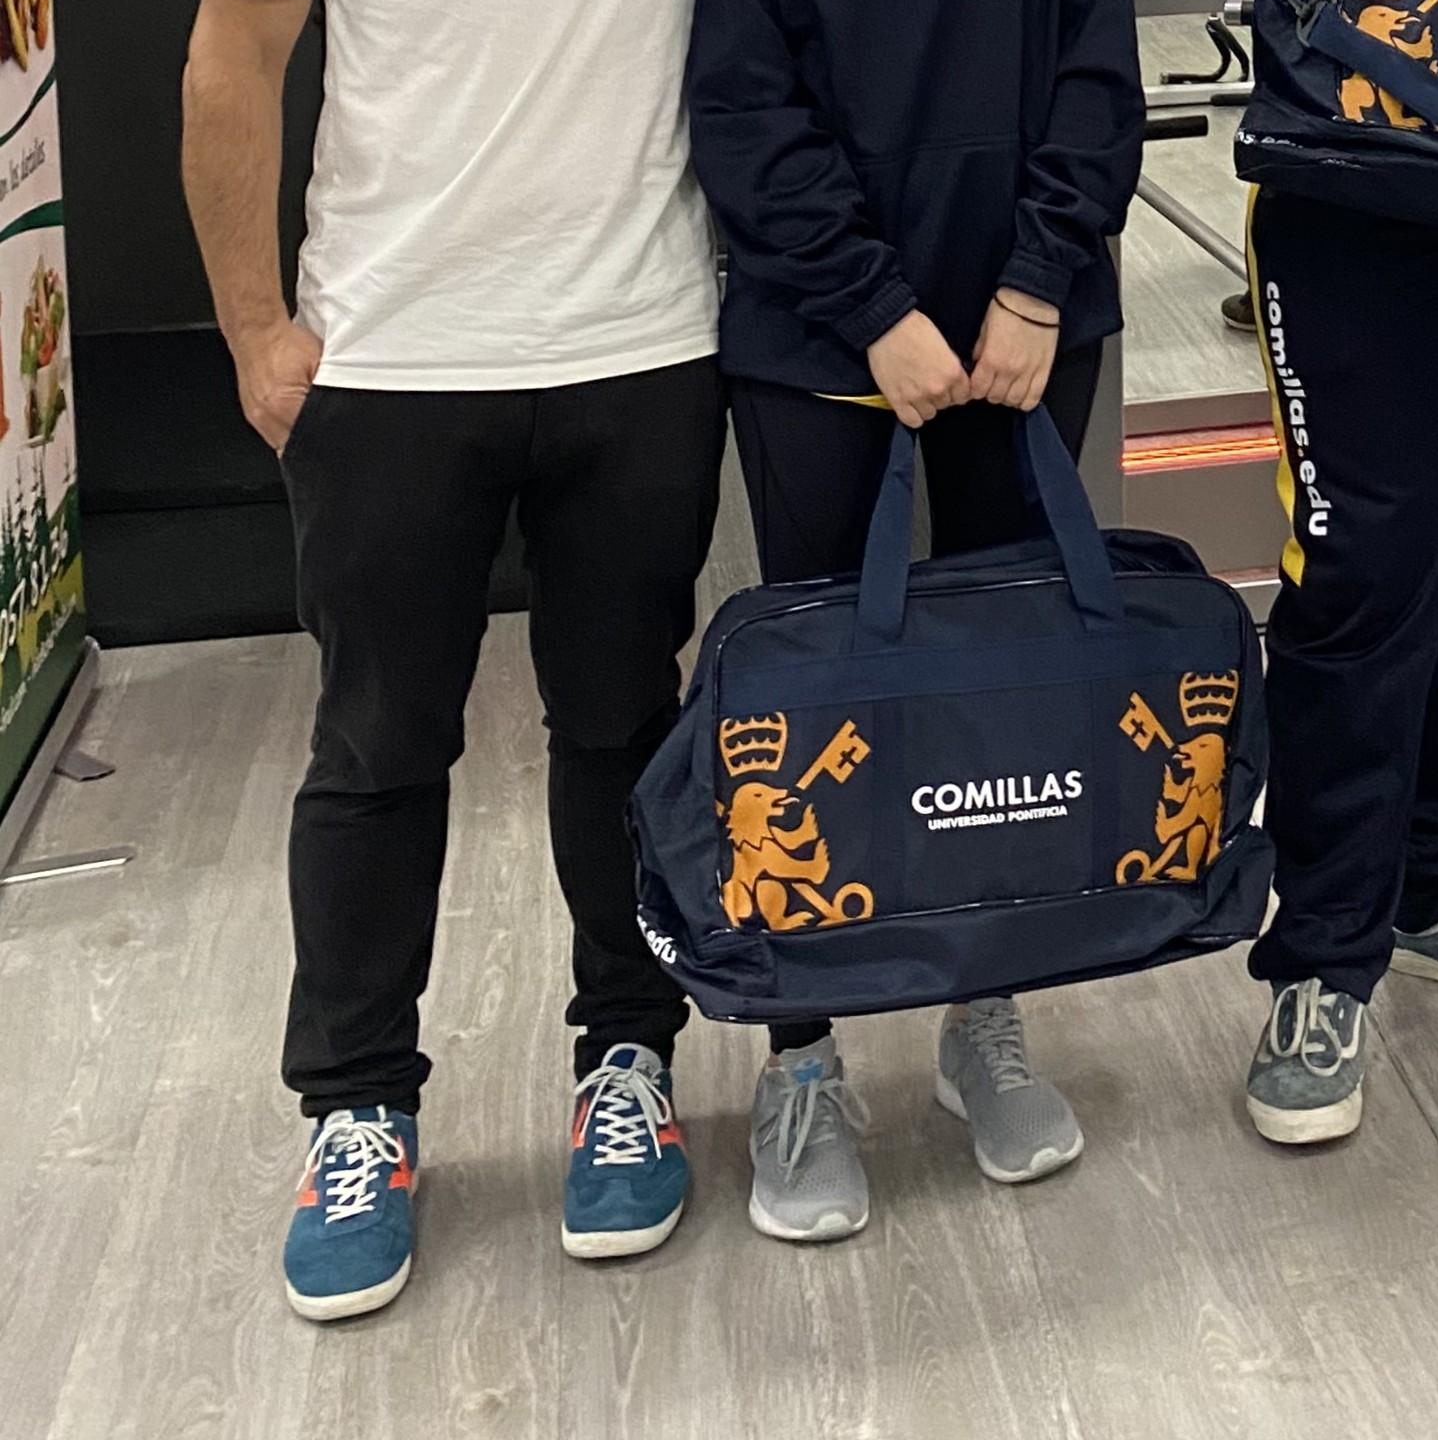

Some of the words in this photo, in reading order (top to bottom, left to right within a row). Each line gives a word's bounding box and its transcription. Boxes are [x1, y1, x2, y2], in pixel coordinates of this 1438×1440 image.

[1266, 281, 1332, 536] comillas.edu
[911, 770, 1083, 815] COMILLAS
[928, 811, 1005, 830] UNIVERSIDAD
[1008, 805, 1067, 822] PONTIFICIA
